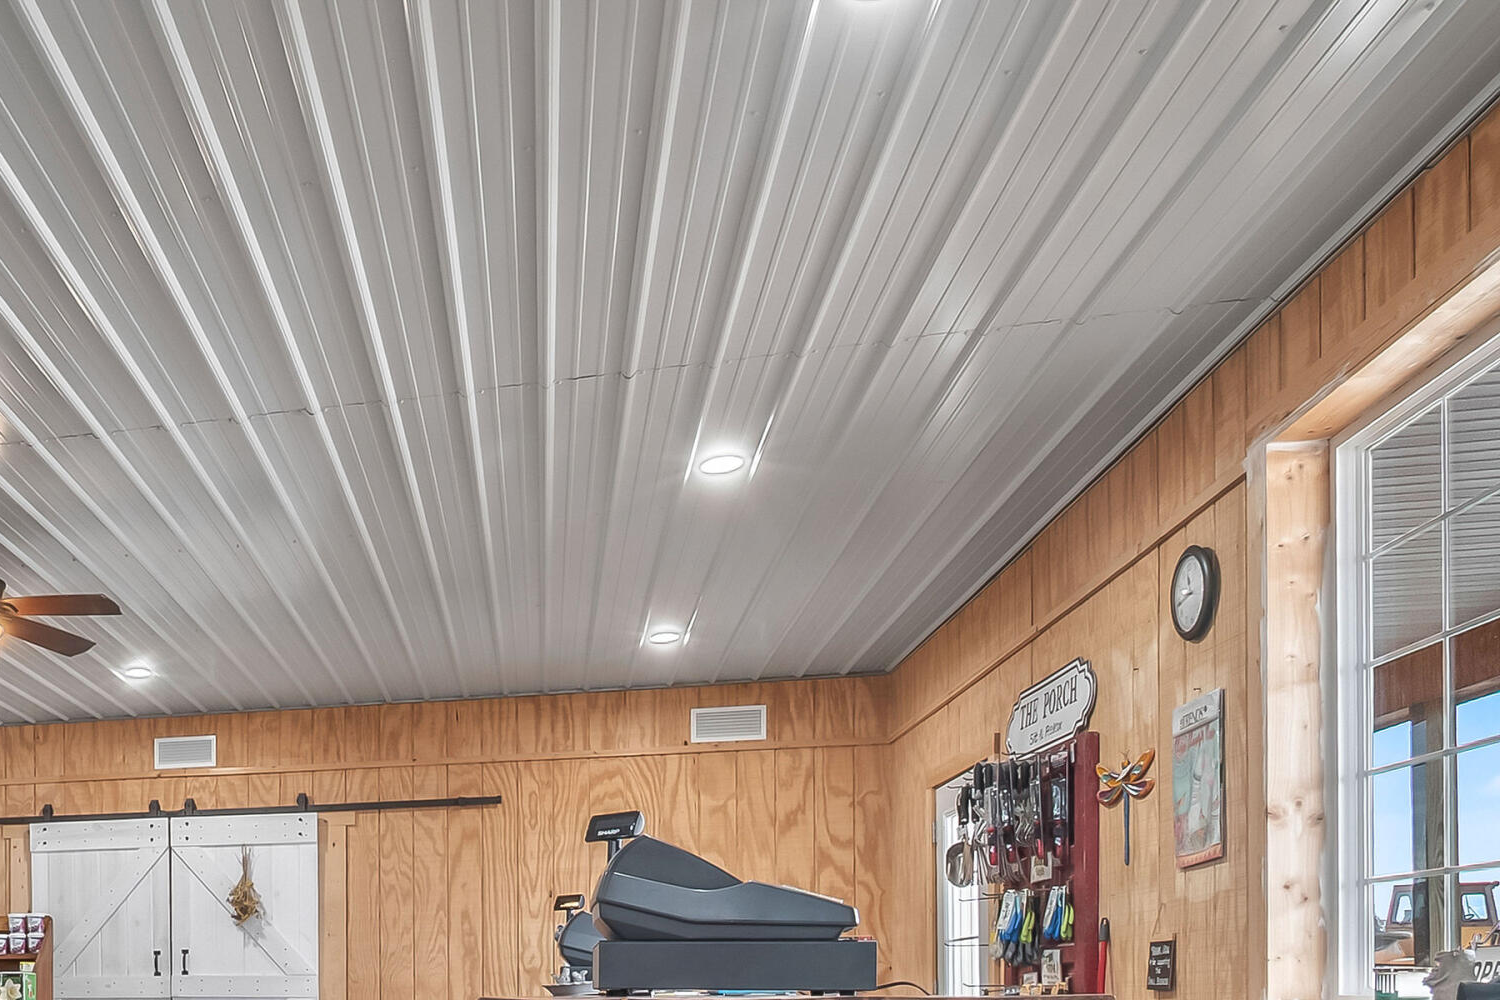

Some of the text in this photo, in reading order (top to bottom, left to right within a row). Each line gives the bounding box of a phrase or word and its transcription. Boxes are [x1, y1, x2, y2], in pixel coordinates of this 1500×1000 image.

[1019, 674, 1078, 731] THE PORCH
[597, 828, 620, 836] SHARP
